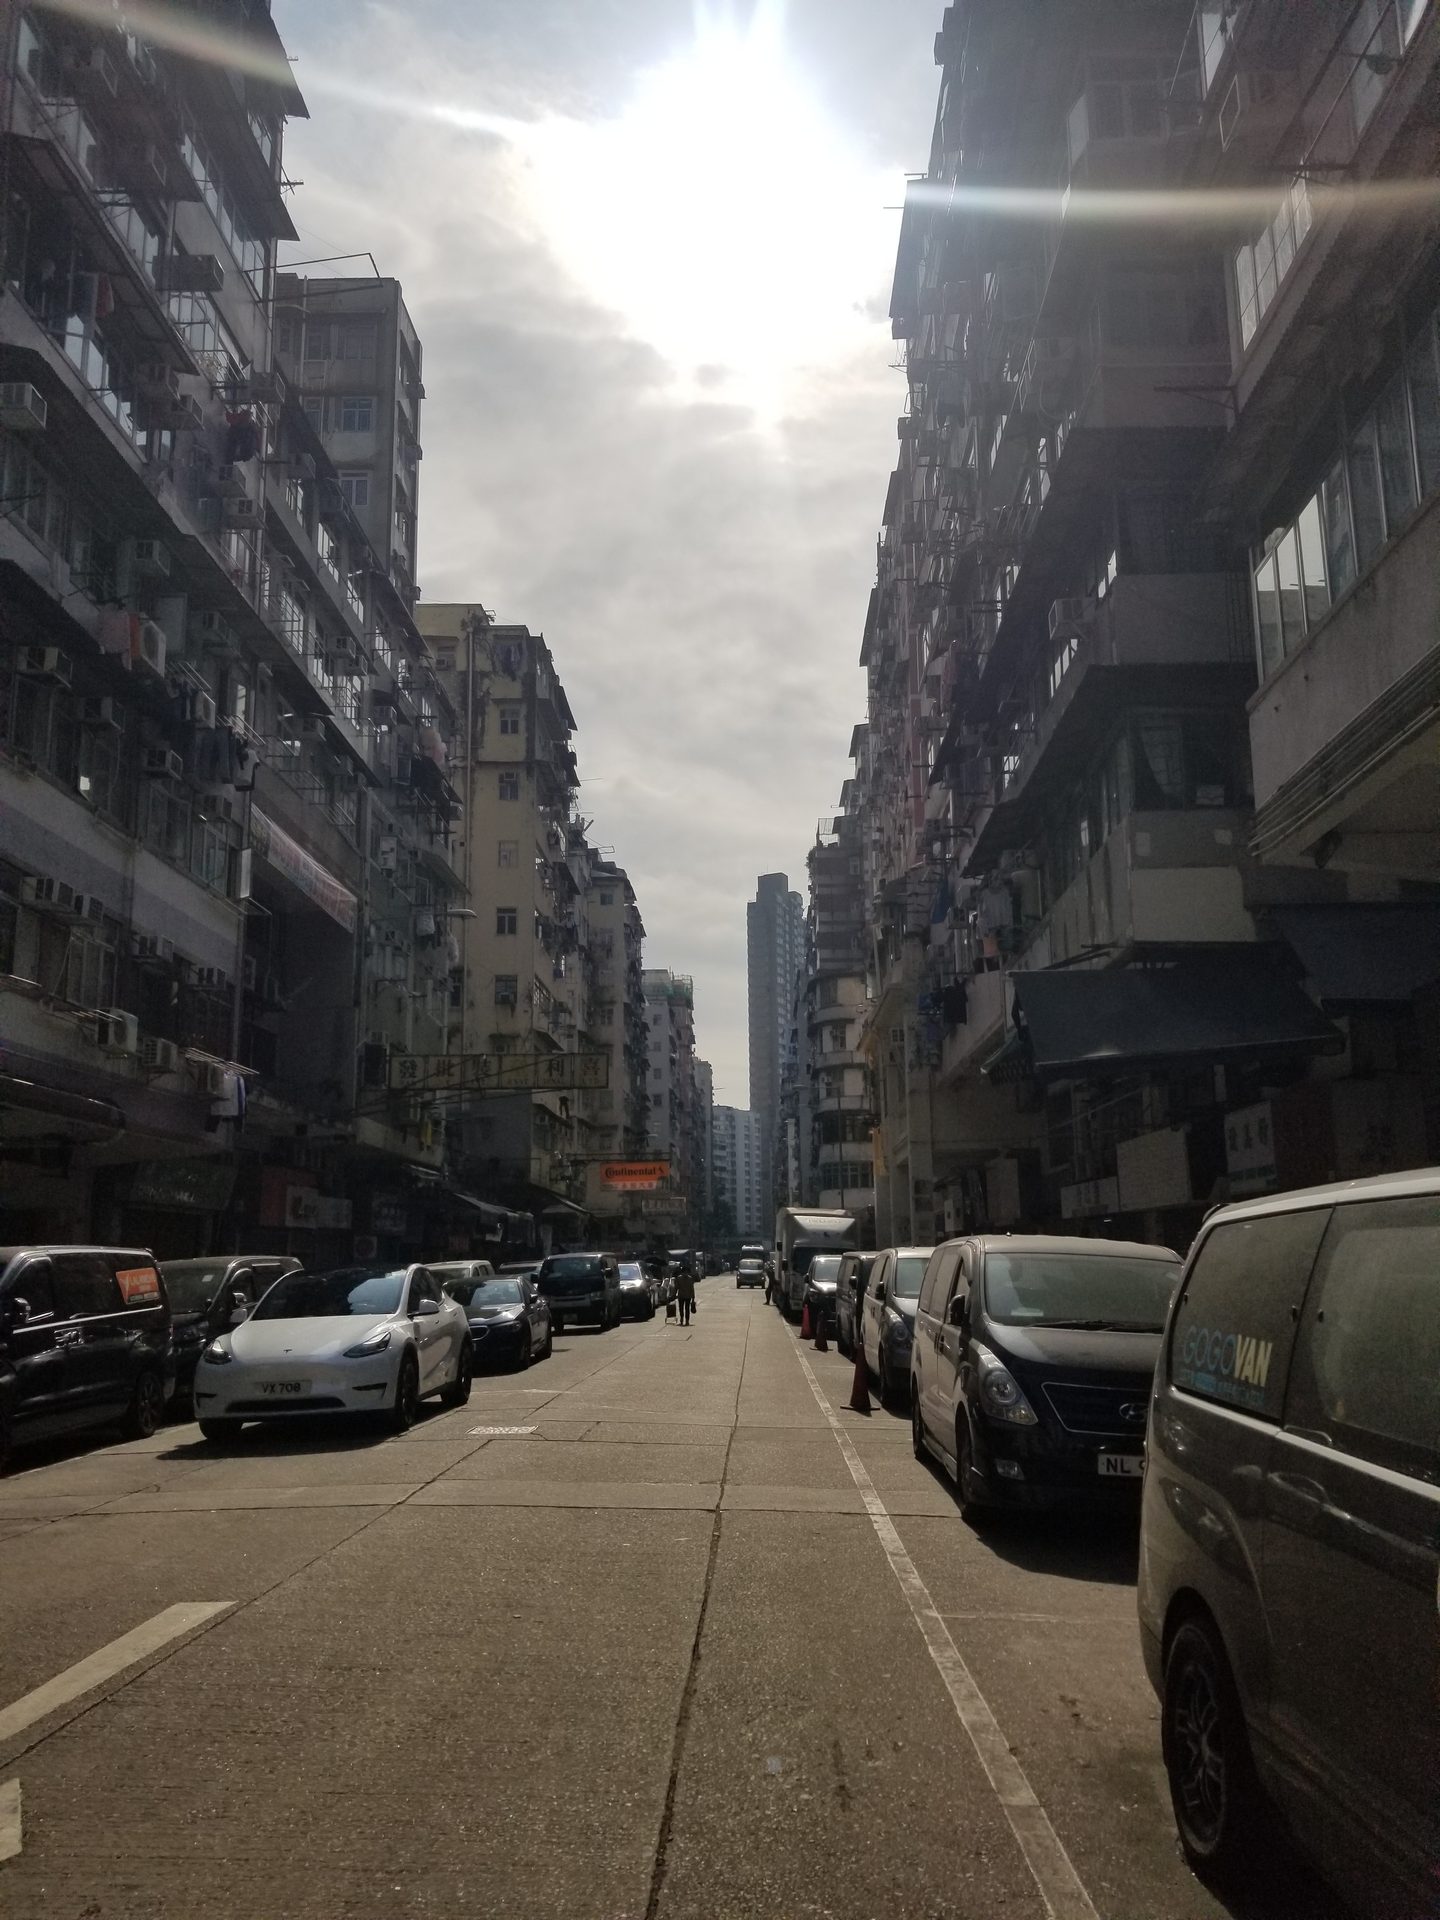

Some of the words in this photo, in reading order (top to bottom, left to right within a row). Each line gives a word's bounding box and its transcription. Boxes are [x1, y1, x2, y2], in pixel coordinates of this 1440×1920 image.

[605, 1166, 656, 1179] Continental
[1183, 1325, 1273, 1387] GOGOVAN
[262, 1383, 276, 1393] VX
[1106, 1457, 1131, 1474] NL
